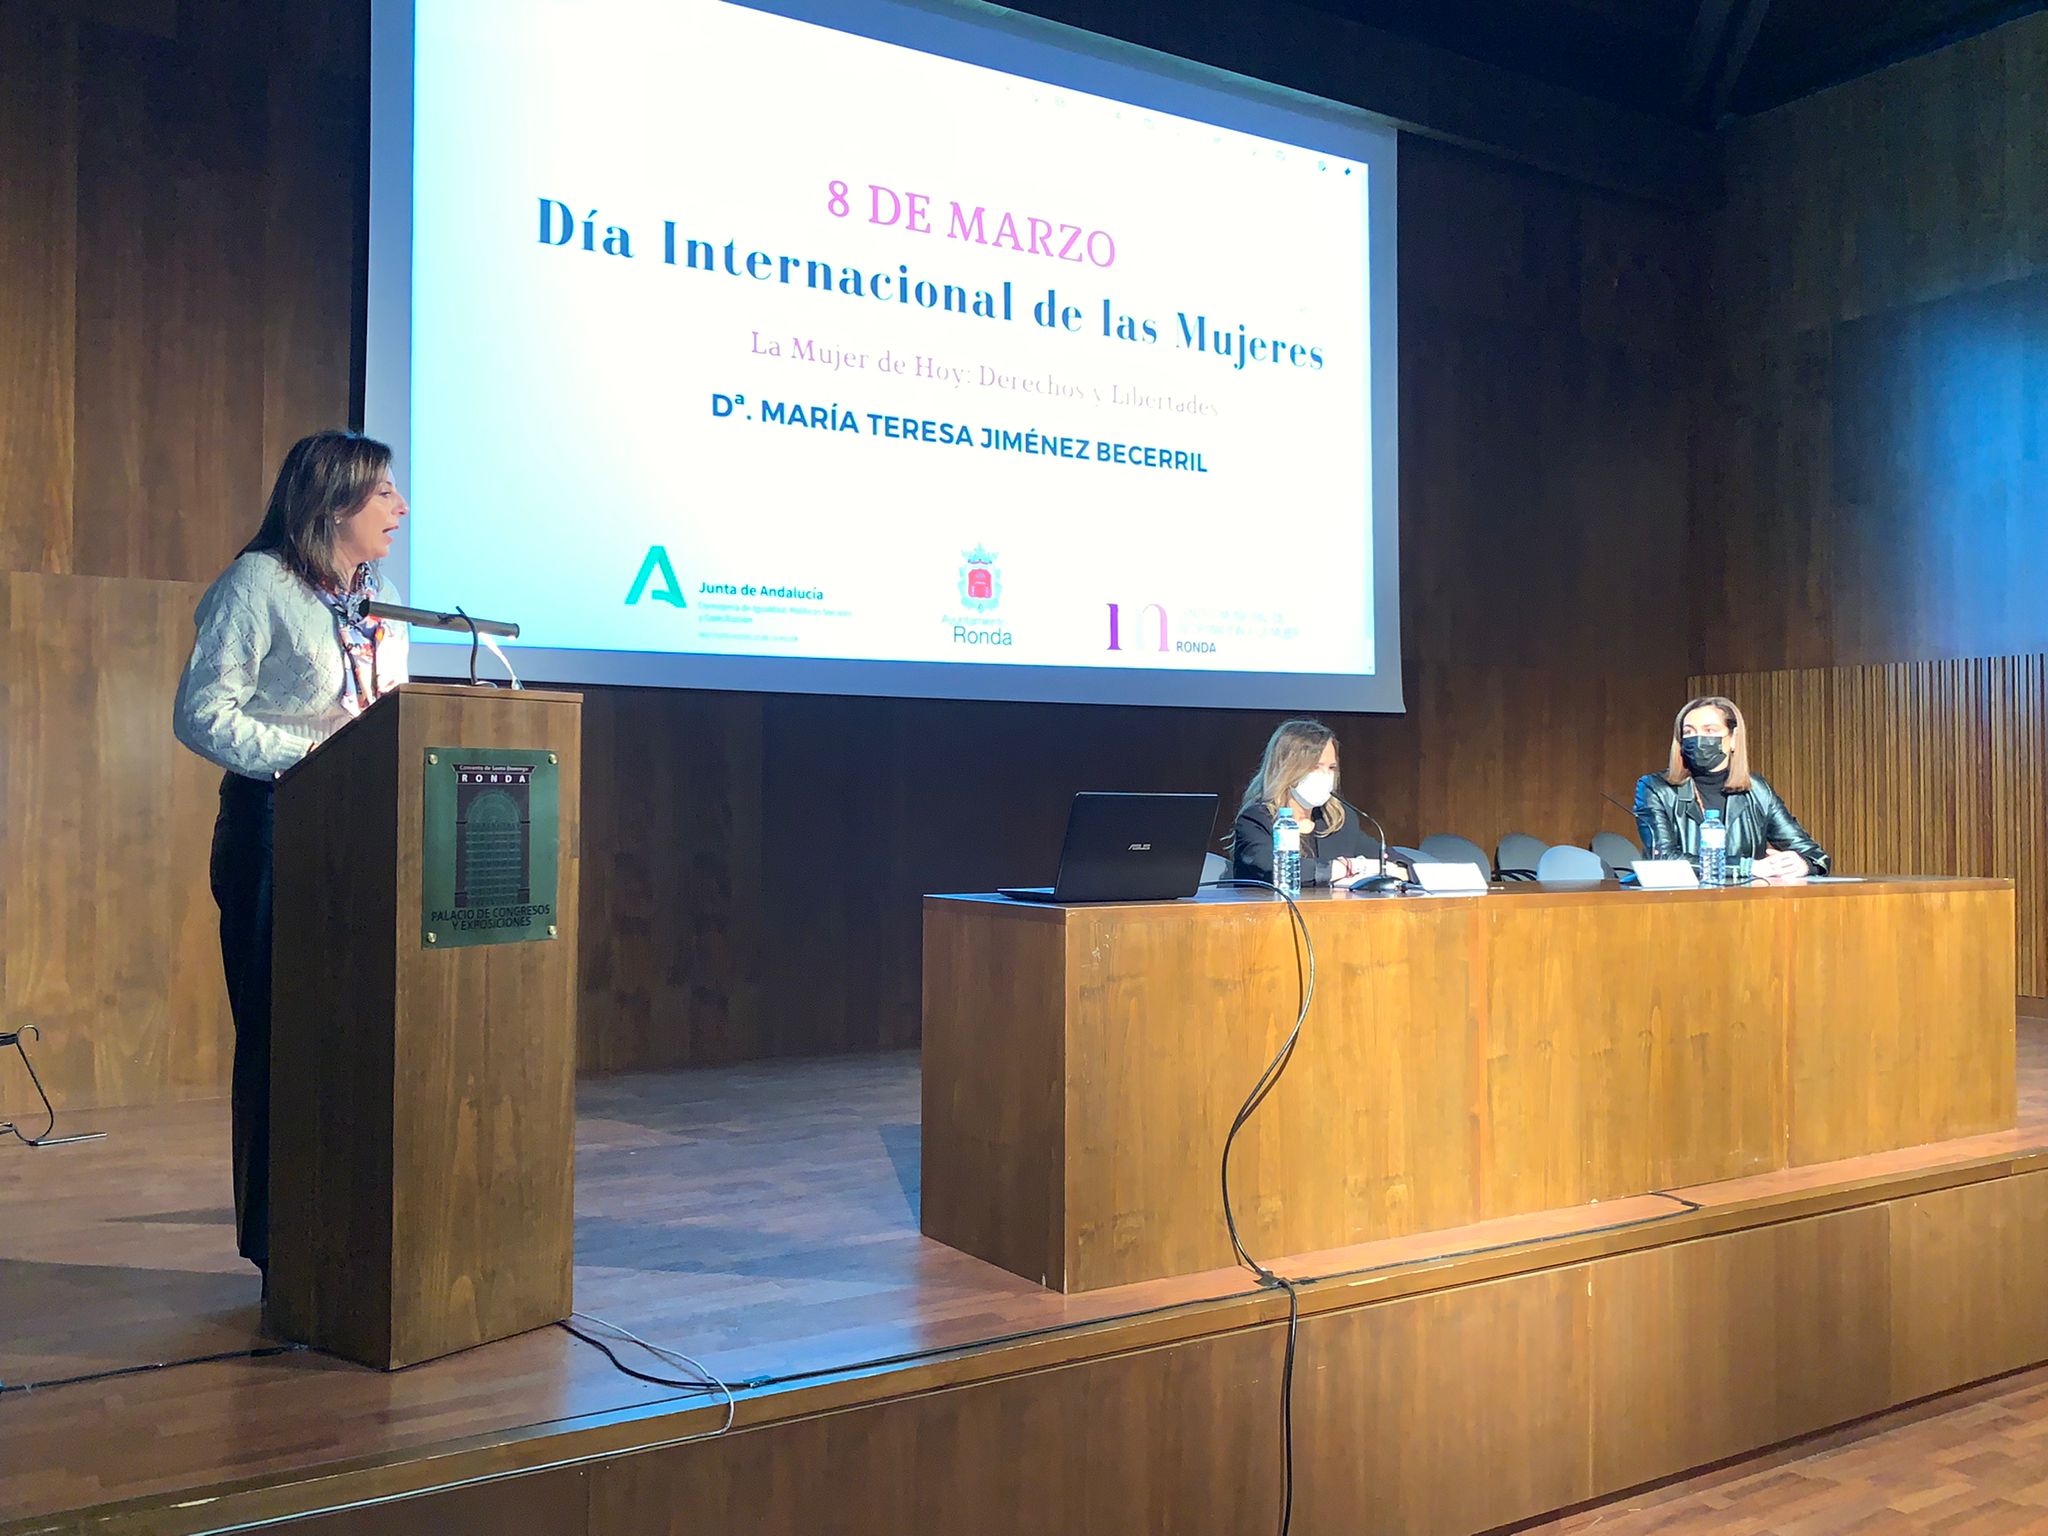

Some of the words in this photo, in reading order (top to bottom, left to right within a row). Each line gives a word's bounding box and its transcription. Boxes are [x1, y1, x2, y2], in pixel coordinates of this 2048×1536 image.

[828, 180, 849, 217] 8
[869, 184, 931, 234] DE
[947, 201, 1116, 268] MARZO
[537, 198, 634, 258] Día
[663, 221, 1012, 320] Internacional
[1034, 290, 1083, 332] de
[1102, 299, 1158, 345] las
[1176, 312, 1325, 371] Mujeres
[751, 331, 781, 358] La
[791, 338, 869, 372] Mujer
[878, 351, 906, 375] de
[979, 365, 1084, 401] Derechos
[1112, 384, 1219, 418] Libertades
[761, 400, 860, 434] MARÍA
[867, 413, 974, 448] TERESA
[980, 429, 1090, 461] JIMÉNEZ
[1097, 442, 1208, 473] BECERRIL
[699, 582, 737, 595] Junta
[741, 584, 758, 597] de
[760, 586, 823, 600] Andalucía
[954, 626, 1012, 646] Ronda
[1176, 641, 1216, 653] RONDA
[462, 774, 526, 784] RONDA
[1128, 843, 1152, 851] ASUS
[431, 909, 475, 921] PALACIO
[477, 908, 490, 919] DE
[492, 904, 550, 918] CONGRESOS
[452, 920, 459, 931] Y
[461, 916, 532, 931] EXPOSICIONES
